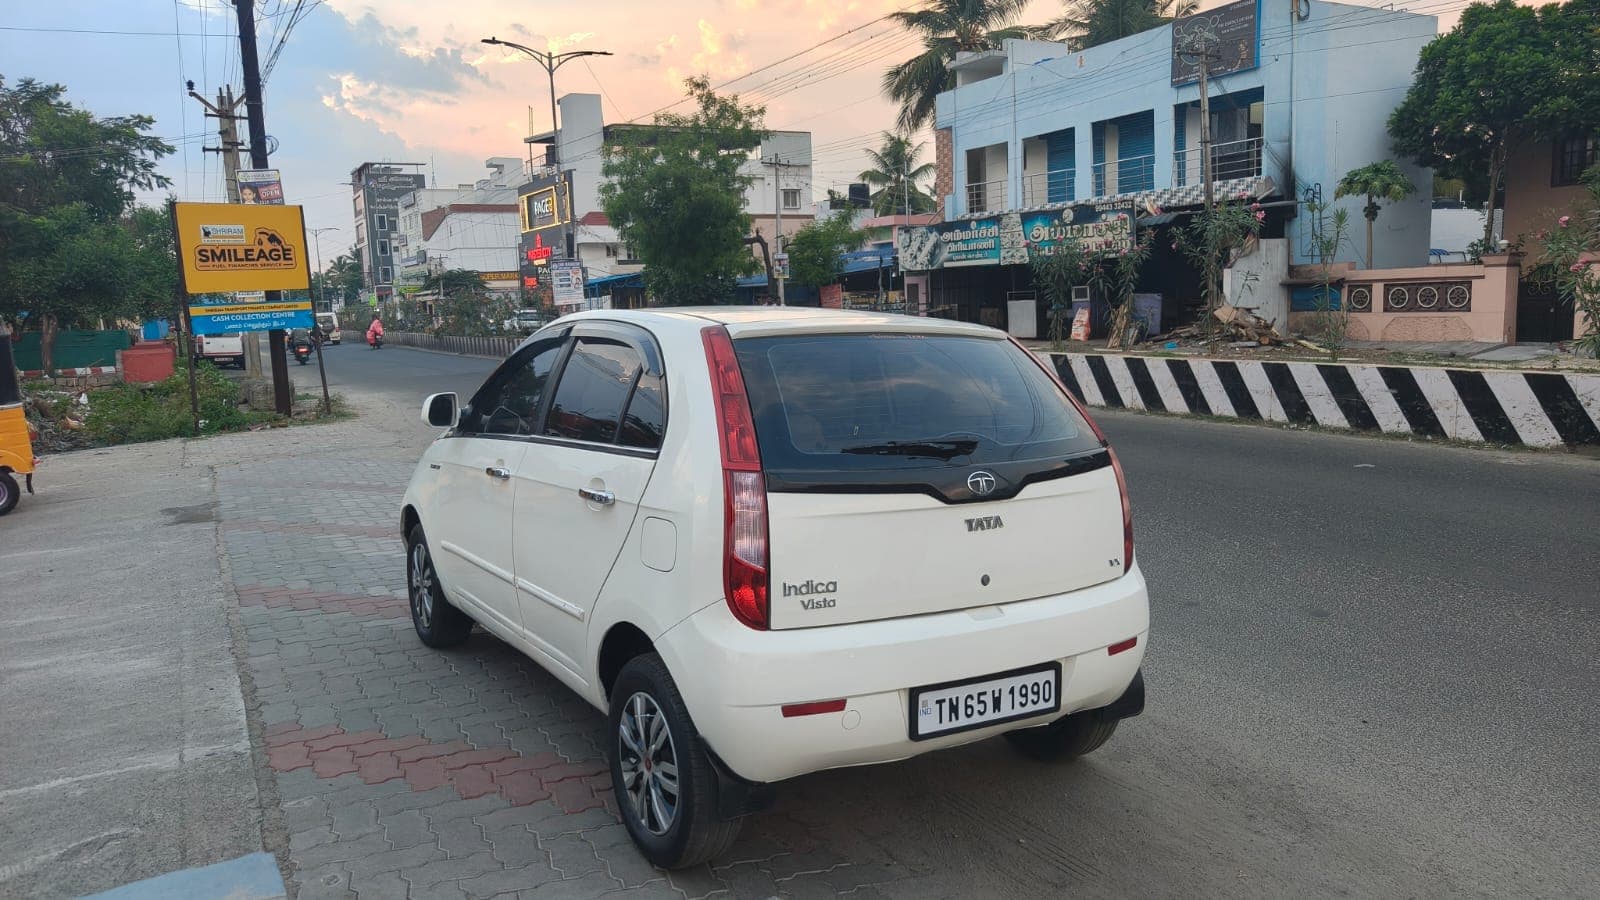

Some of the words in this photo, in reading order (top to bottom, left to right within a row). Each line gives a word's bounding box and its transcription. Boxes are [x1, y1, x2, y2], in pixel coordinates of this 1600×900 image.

[211, 226, 244, 235] SHRIRAM
[197, 247, 293, 263] SMILEAGE
[211, 315, 230, 323] CASH
[230, 312, 271, 321] COLLECTION
[271, 311, 296, 319] CENTRE
[965, 515, 1004, 532] TATA
[783, 580, 838, 597] Indica
[800, 597, 837, 610] Vista
